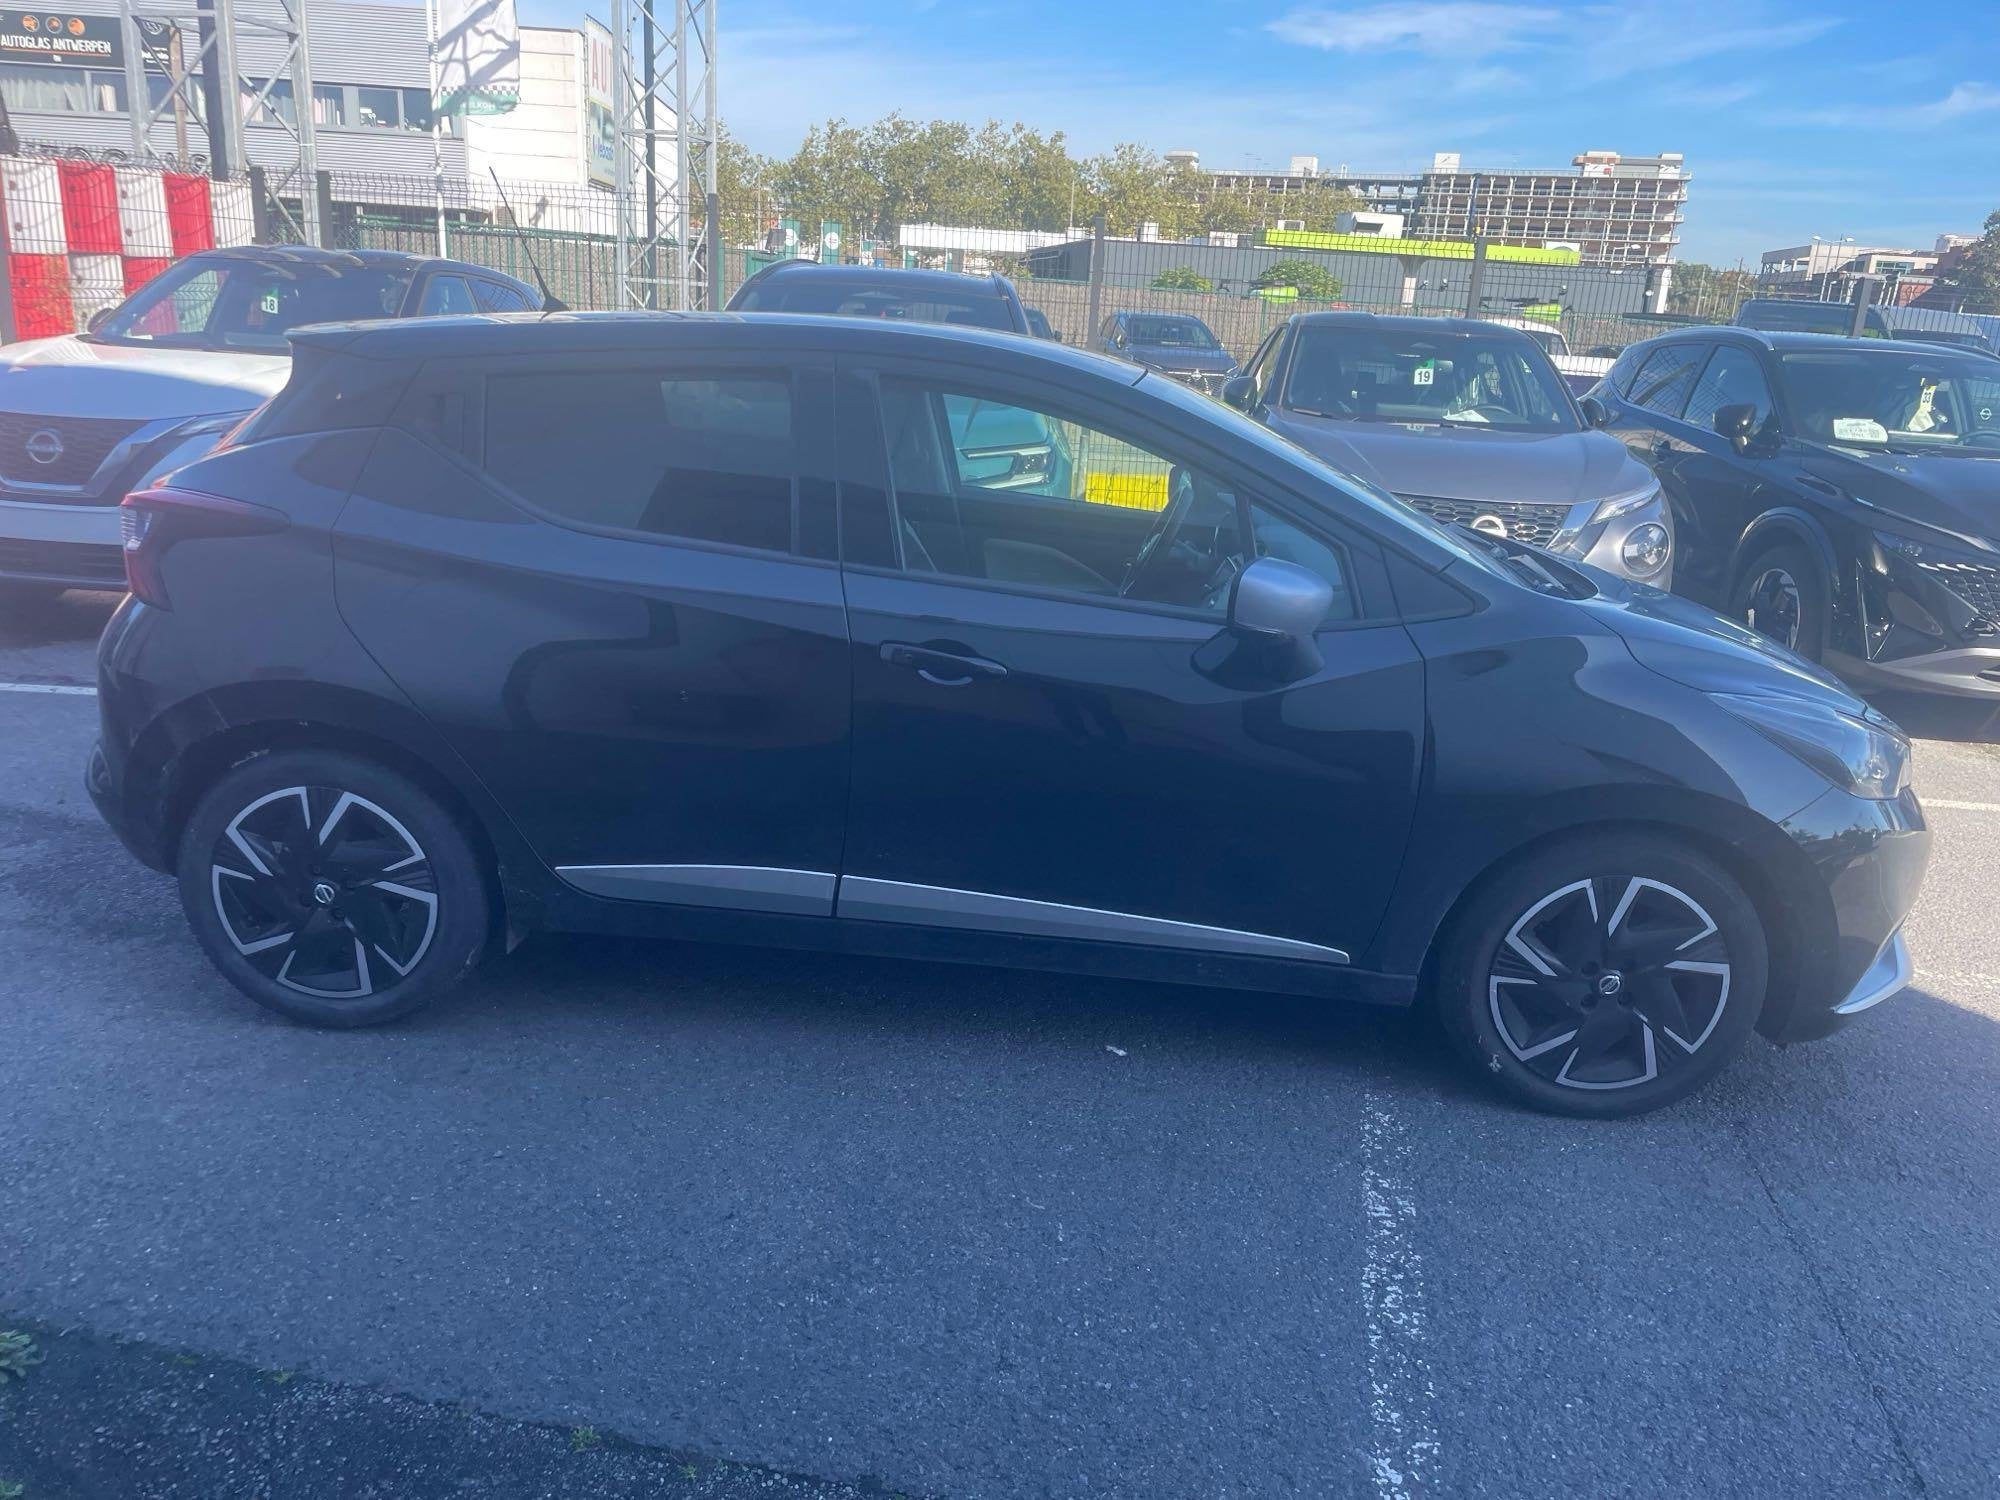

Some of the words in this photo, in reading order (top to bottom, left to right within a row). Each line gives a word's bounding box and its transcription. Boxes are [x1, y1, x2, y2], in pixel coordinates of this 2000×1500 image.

[0, 34, 51, 50] AUTOGLAS
[52, 38, 112, 54] ANTWERPEN
[264, 299, 275, 311] 18
[1417, 370, 1431, 383] 19
